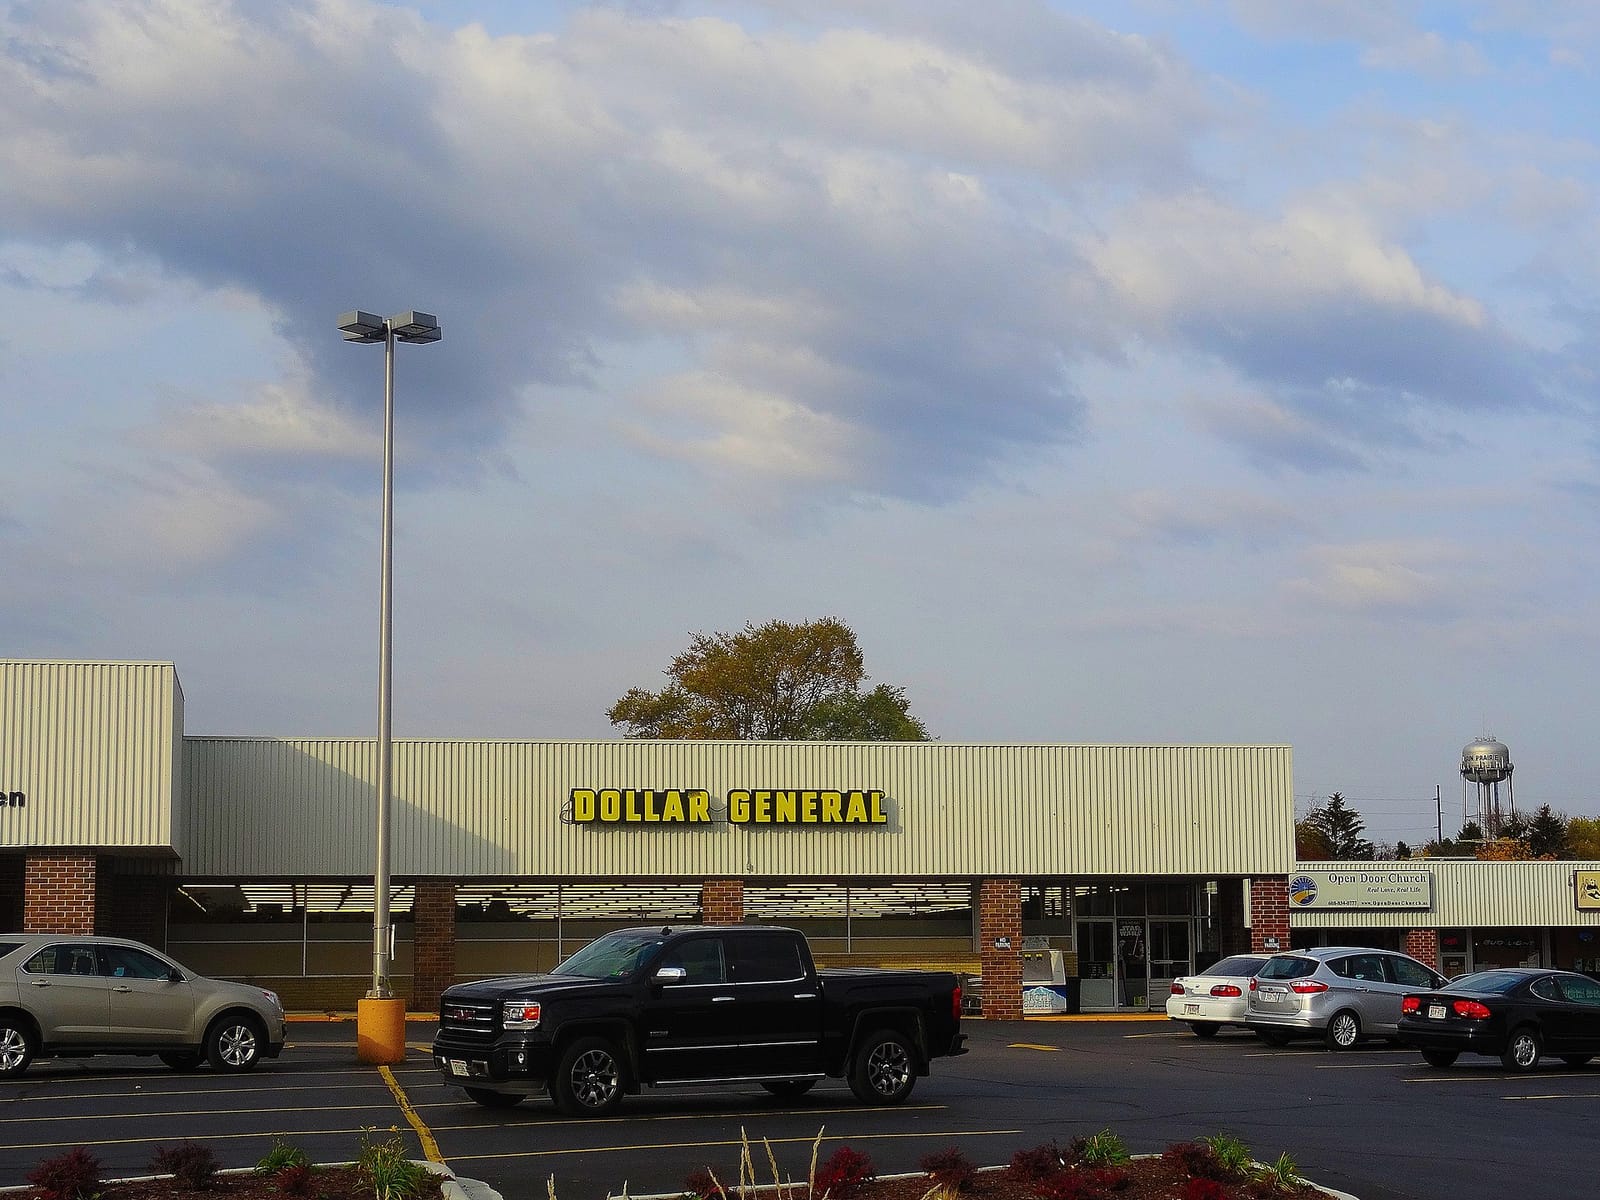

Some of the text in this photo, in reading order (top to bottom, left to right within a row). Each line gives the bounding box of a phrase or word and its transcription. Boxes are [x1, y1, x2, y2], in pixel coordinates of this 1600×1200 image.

[572, 789, 888, 824] DOLLAR GENERAL
[1328, 873, 1427, 885] Open Door Church
